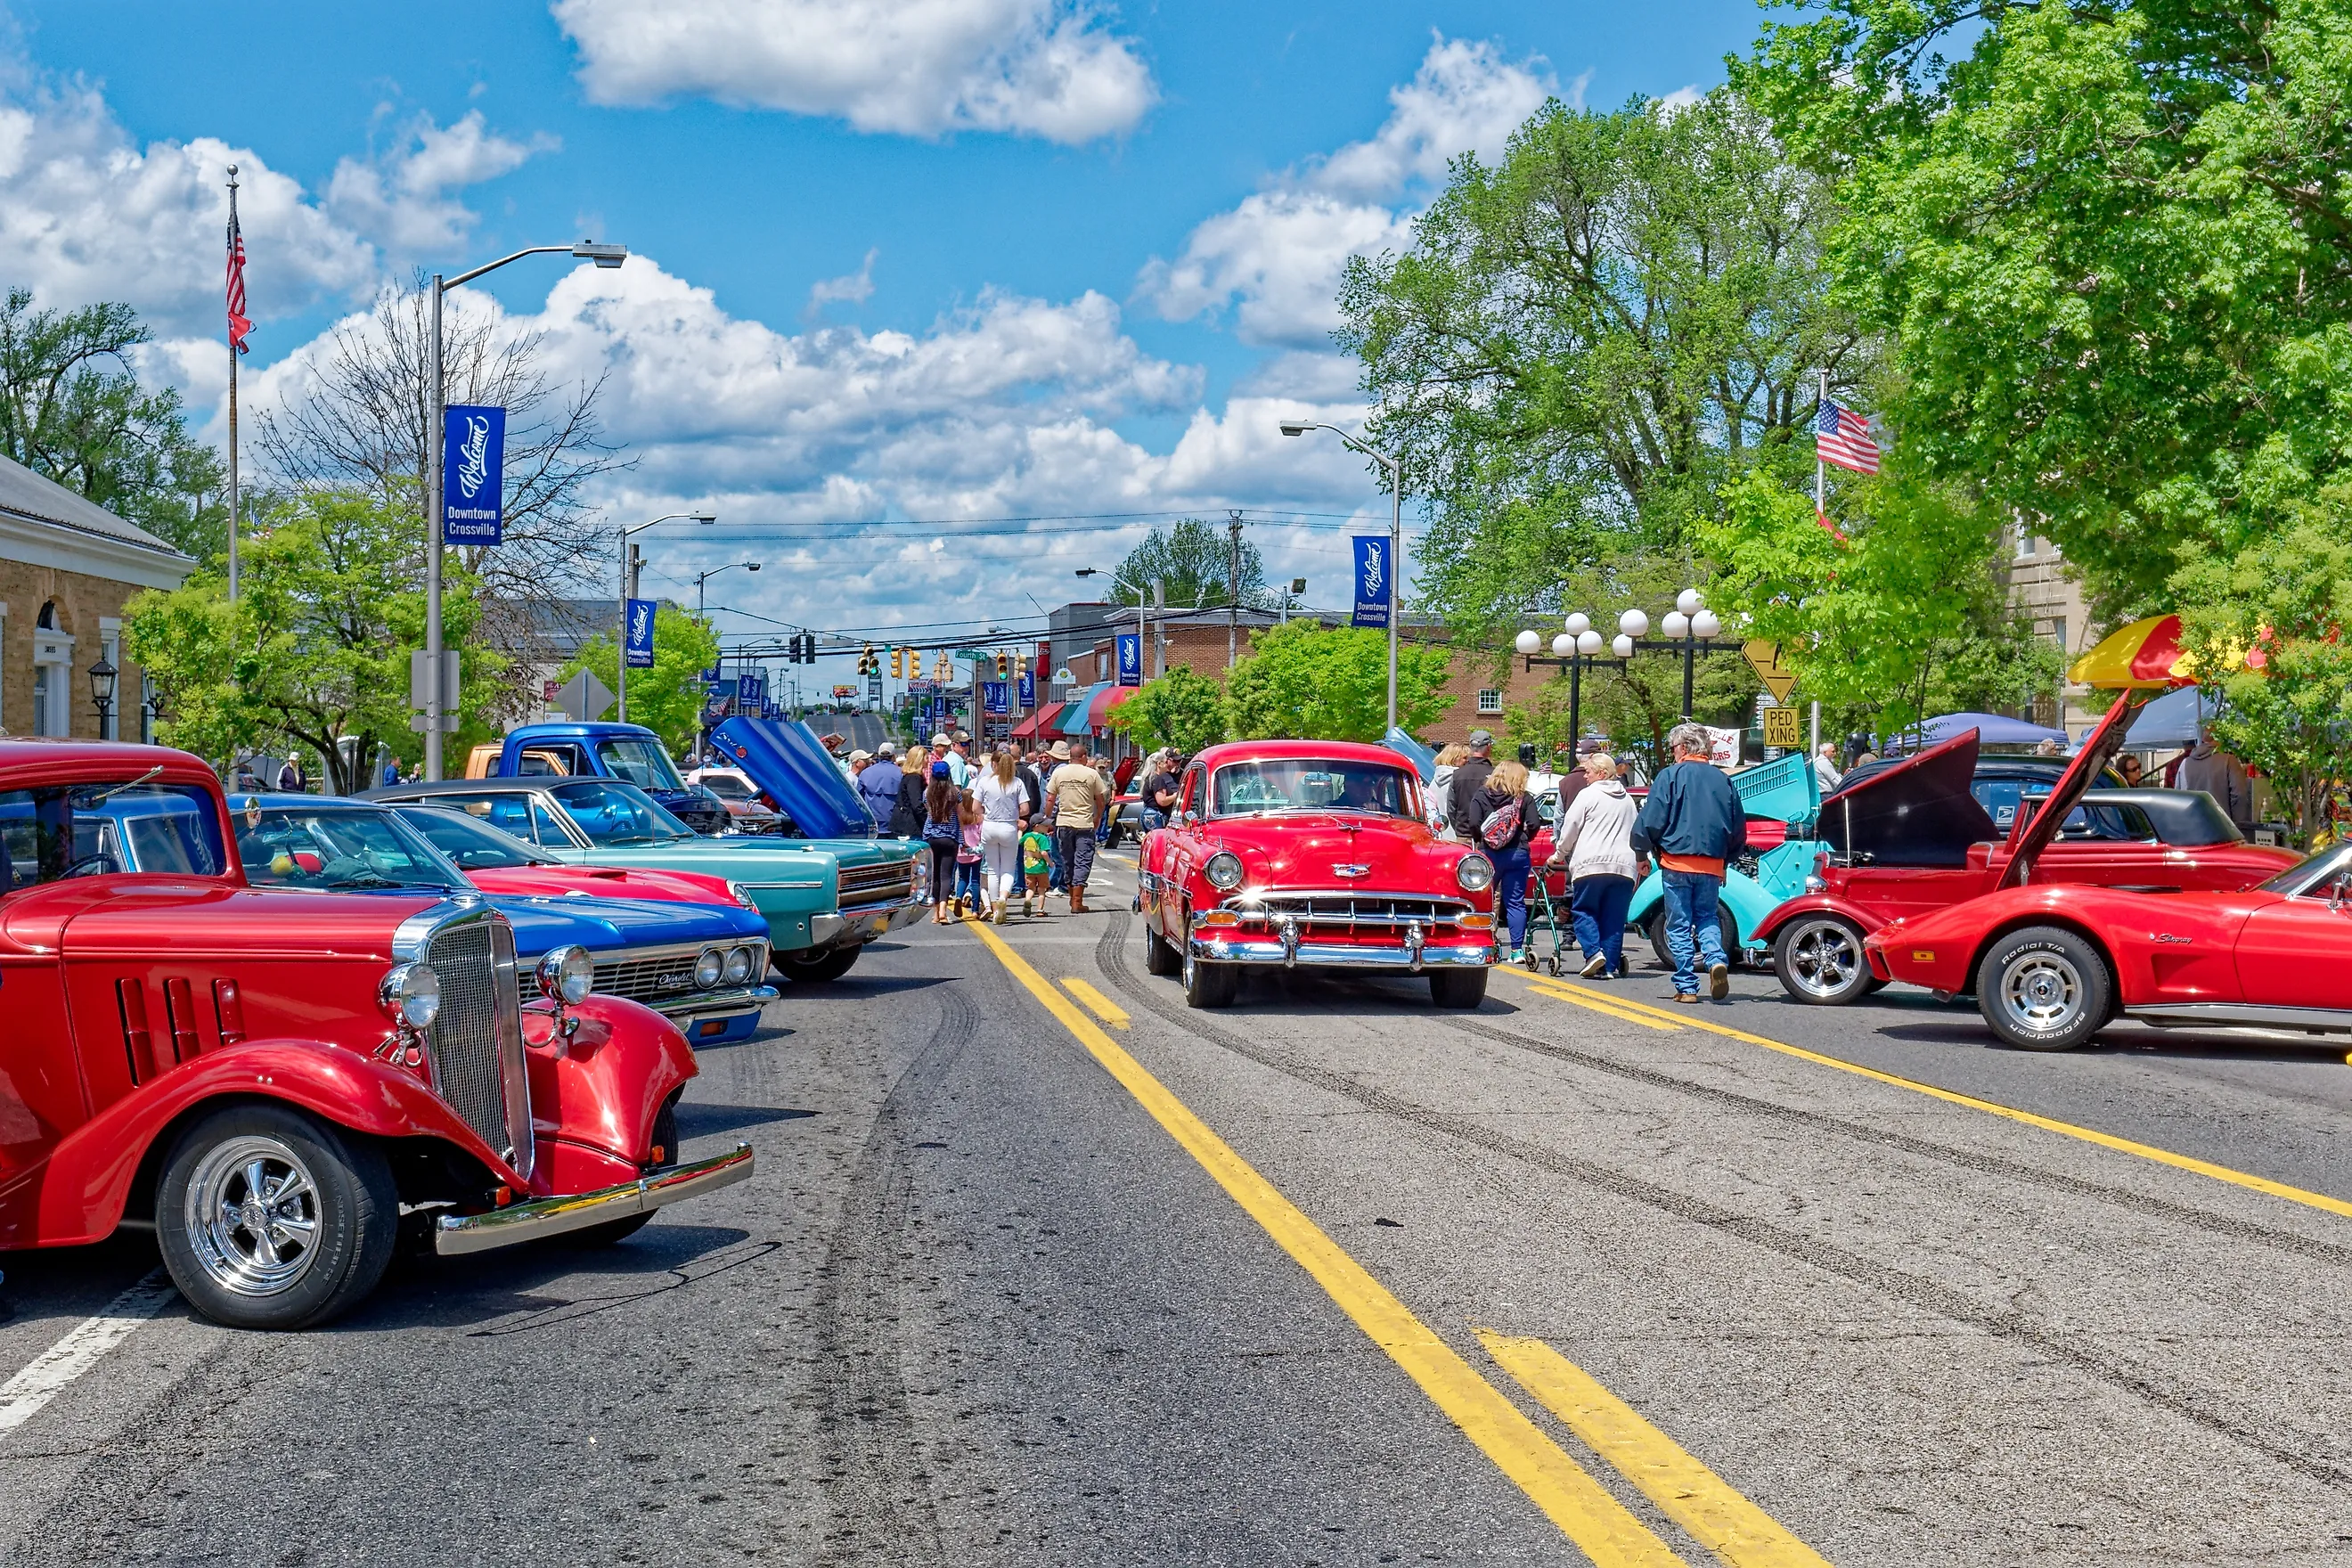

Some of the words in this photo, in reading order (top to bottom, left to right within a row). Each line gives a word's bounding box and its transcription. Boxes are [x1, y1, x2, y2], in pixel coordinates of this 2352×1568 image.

[459, 415, 489, 499] Welcome
[447, 506, 496, 520] Downtown
[449, 521, 495, 536] Crossville
[1364, 542, 1383, 598] Welcome
[1357, 601, 1388, 612] Downtown
[1356, 612, 1386, 622] Crossville
[956, 650, 976, 659] Fourth
[978, 652, 986, 660] St
[1769, 711, 1793, 727] PED
[1706, 729, 1735, 746] SVILLE
[1768, 727, 1796, 743] XING
[1710, 750, 1731, 761] ERS
[2001, 942, 2042, 965] Radial
[2046, 943, 2065, 954] T/A
[2009, 1011, 2086, 1041] BFGoodrich
